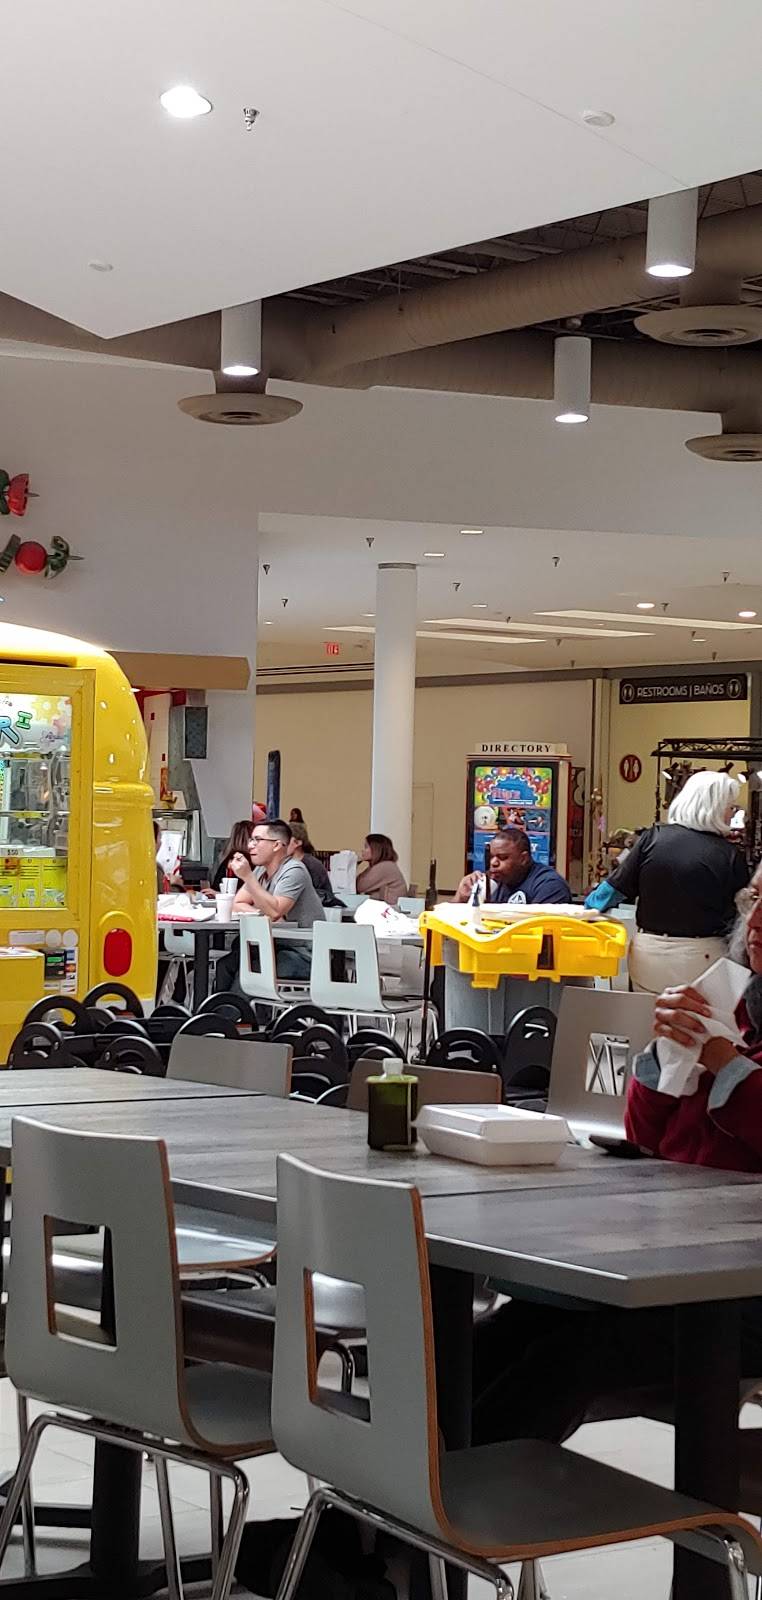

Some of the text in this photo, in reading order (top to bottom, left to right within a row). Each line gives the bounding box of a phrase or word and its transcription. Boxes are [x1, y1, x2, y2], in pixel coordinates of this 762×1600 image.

[637, 683, 725, 698] RESTROOMS BAÑOS
[481, 744, 552, 753] DIRECTORY
